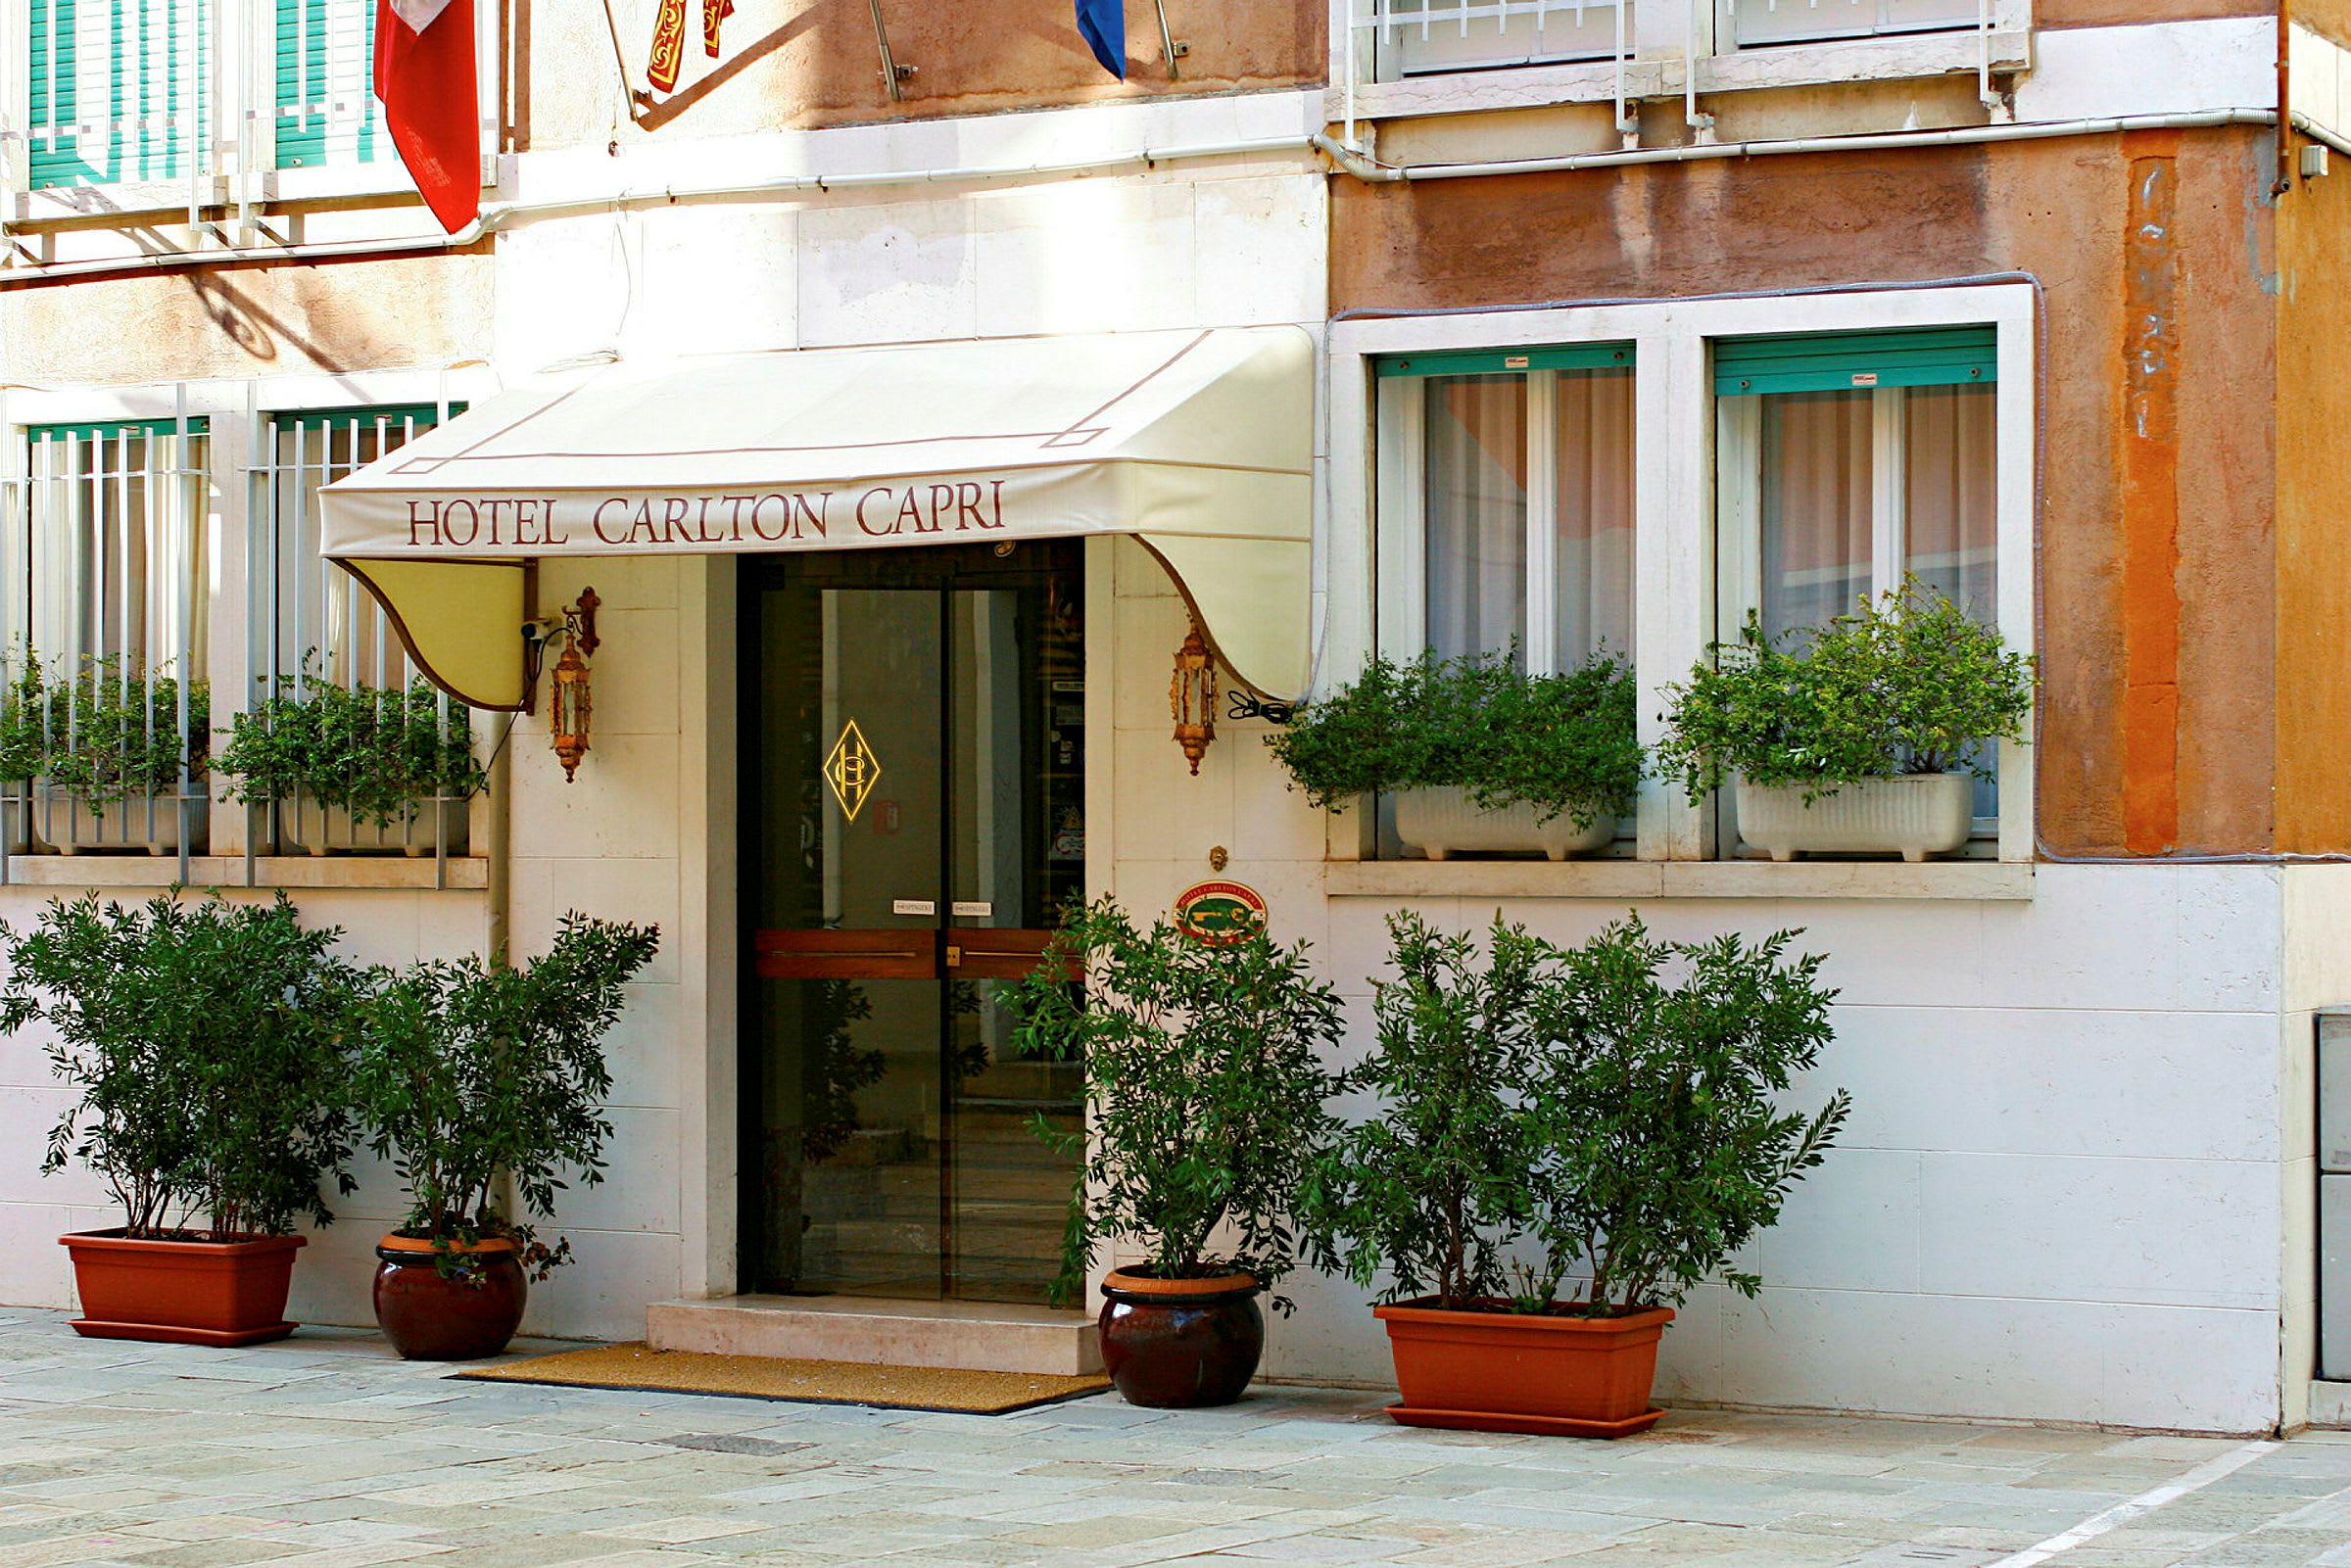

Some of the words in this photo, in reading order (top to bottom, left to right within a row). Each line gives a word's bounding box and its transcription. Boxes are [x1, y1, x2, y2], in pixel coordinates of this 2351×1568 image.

[406, 499, 569, 546] HOTEL
[592, 492, 833, 545] CARLTON
[855, 480, 1006, 537] CAPRI
